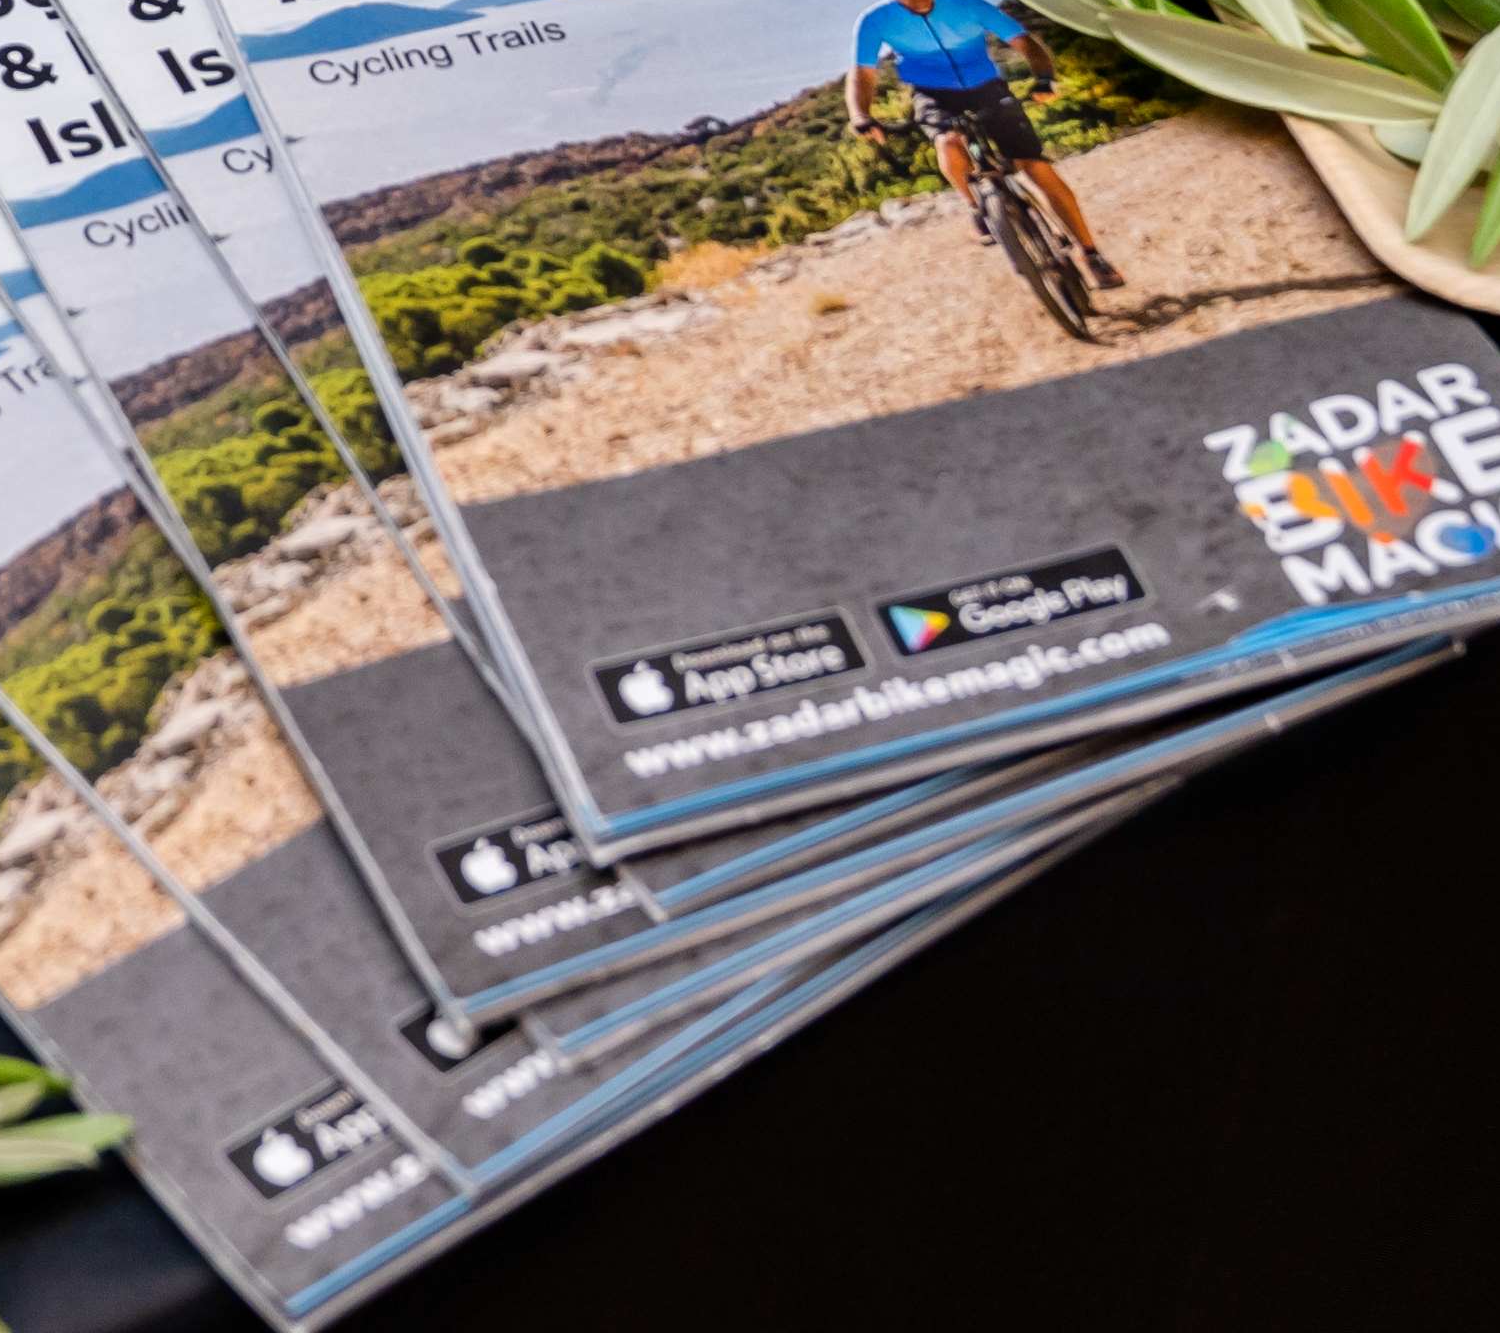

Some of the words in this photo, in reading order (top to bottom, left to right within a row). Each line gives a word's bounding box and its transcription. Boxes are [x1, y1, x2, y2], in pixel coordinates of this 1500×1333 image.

[308, 39, 455, 87] Cycling
[457, 18, 568, 58] Trails
[1202, 362, 1492, 483] ZADAR
[959, 588, 1071, 633] Google
[1061, 573, 1128, 609] Play
[623, 621, 1173, 780] www.zadarbikemagic.com
[684, 665, 758, 704] App
[751, 644, 846, 687] Store
